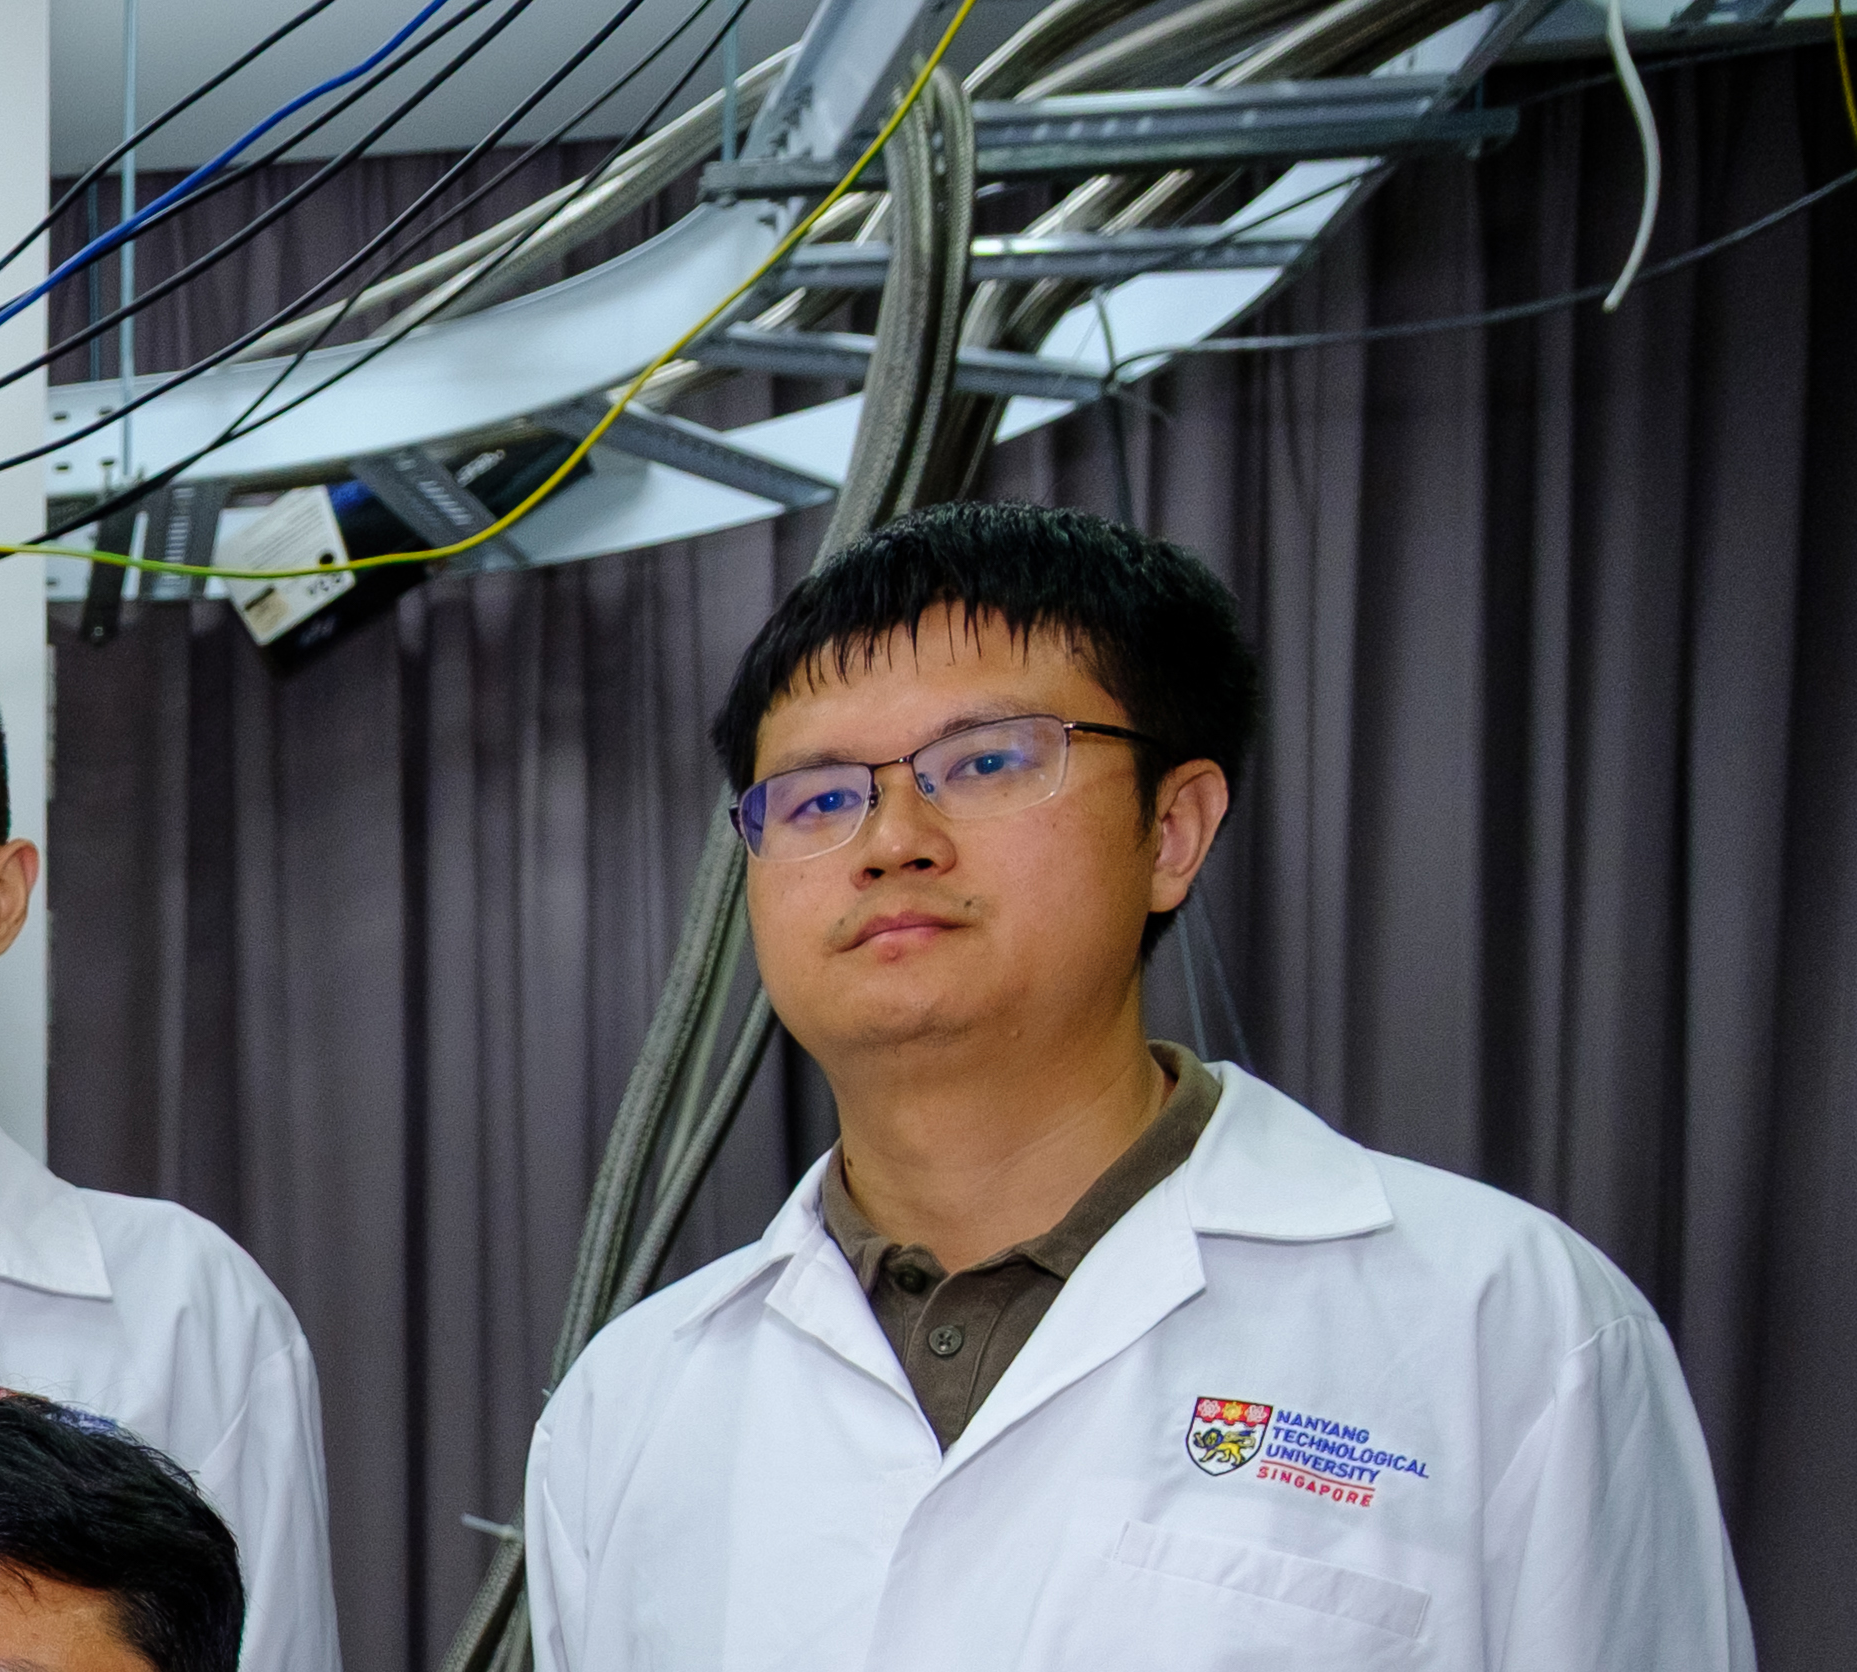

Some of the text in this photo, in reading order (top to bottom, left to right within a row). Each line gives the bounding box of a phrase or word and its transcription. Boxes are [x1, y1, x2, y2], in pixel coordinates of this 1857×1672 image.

[1276, 1410, 1370, 1444] NANYANG
[1265, 1443, 1380, 1484] UNIVERSITY
[1272, 1426, 1429, 1479] TECHNOLOGICAL
[1257, 1466, 1374, 1508] SINGAPORE
